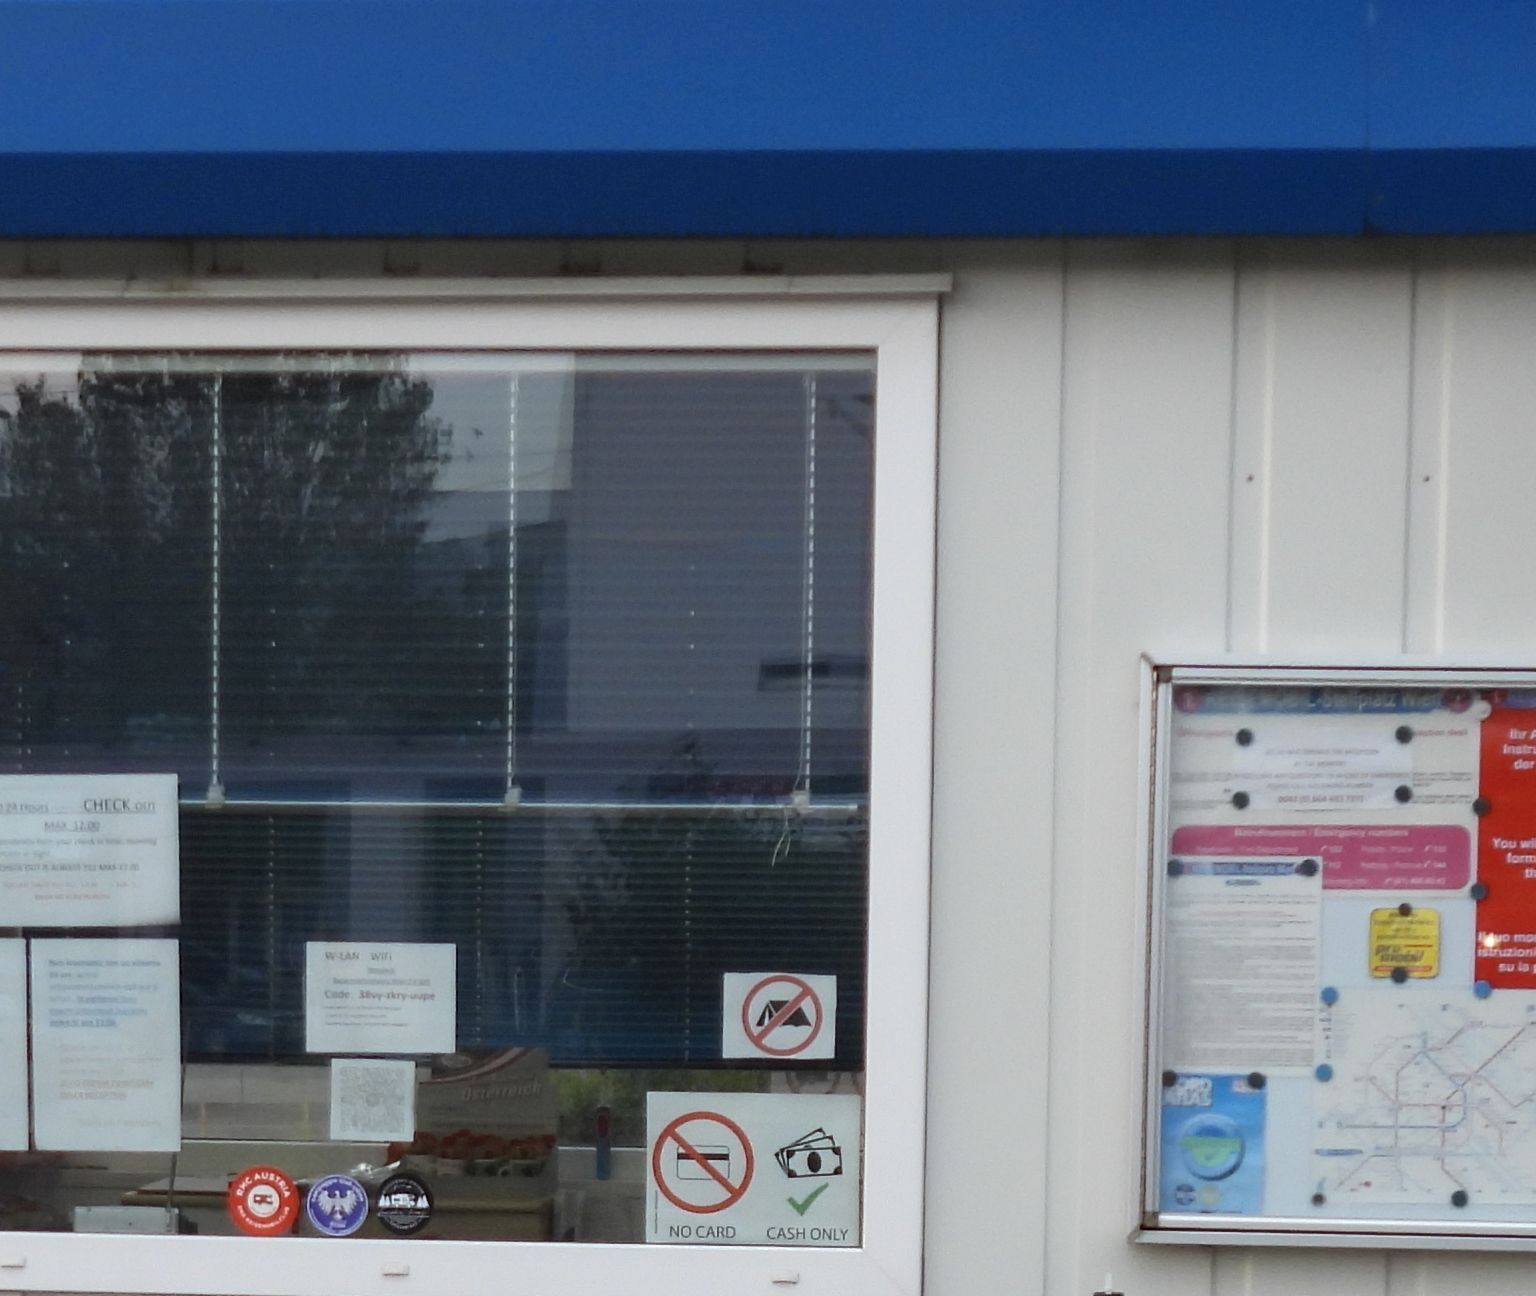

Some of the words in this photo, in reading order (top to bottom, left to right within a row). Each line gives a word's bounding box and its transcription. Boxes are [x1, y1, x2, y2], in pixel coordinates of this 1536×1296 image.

[1514, 758, 1535, 769] der
[83, 799, 131, 813] CHECK
[1492, 838, 1517, 849] You
[1506, 853, 1536, 864] form
[1498, 964, 1514, 972] su
[254, 1171, 291, 1198] AUSTRIA
[669, 1225, 692, 1238] NO
[695, 1225, 736, 1239] CARD
[766, 1226, 806, 1240] CASH
[810, 1227, 849, 1241] ONLY
